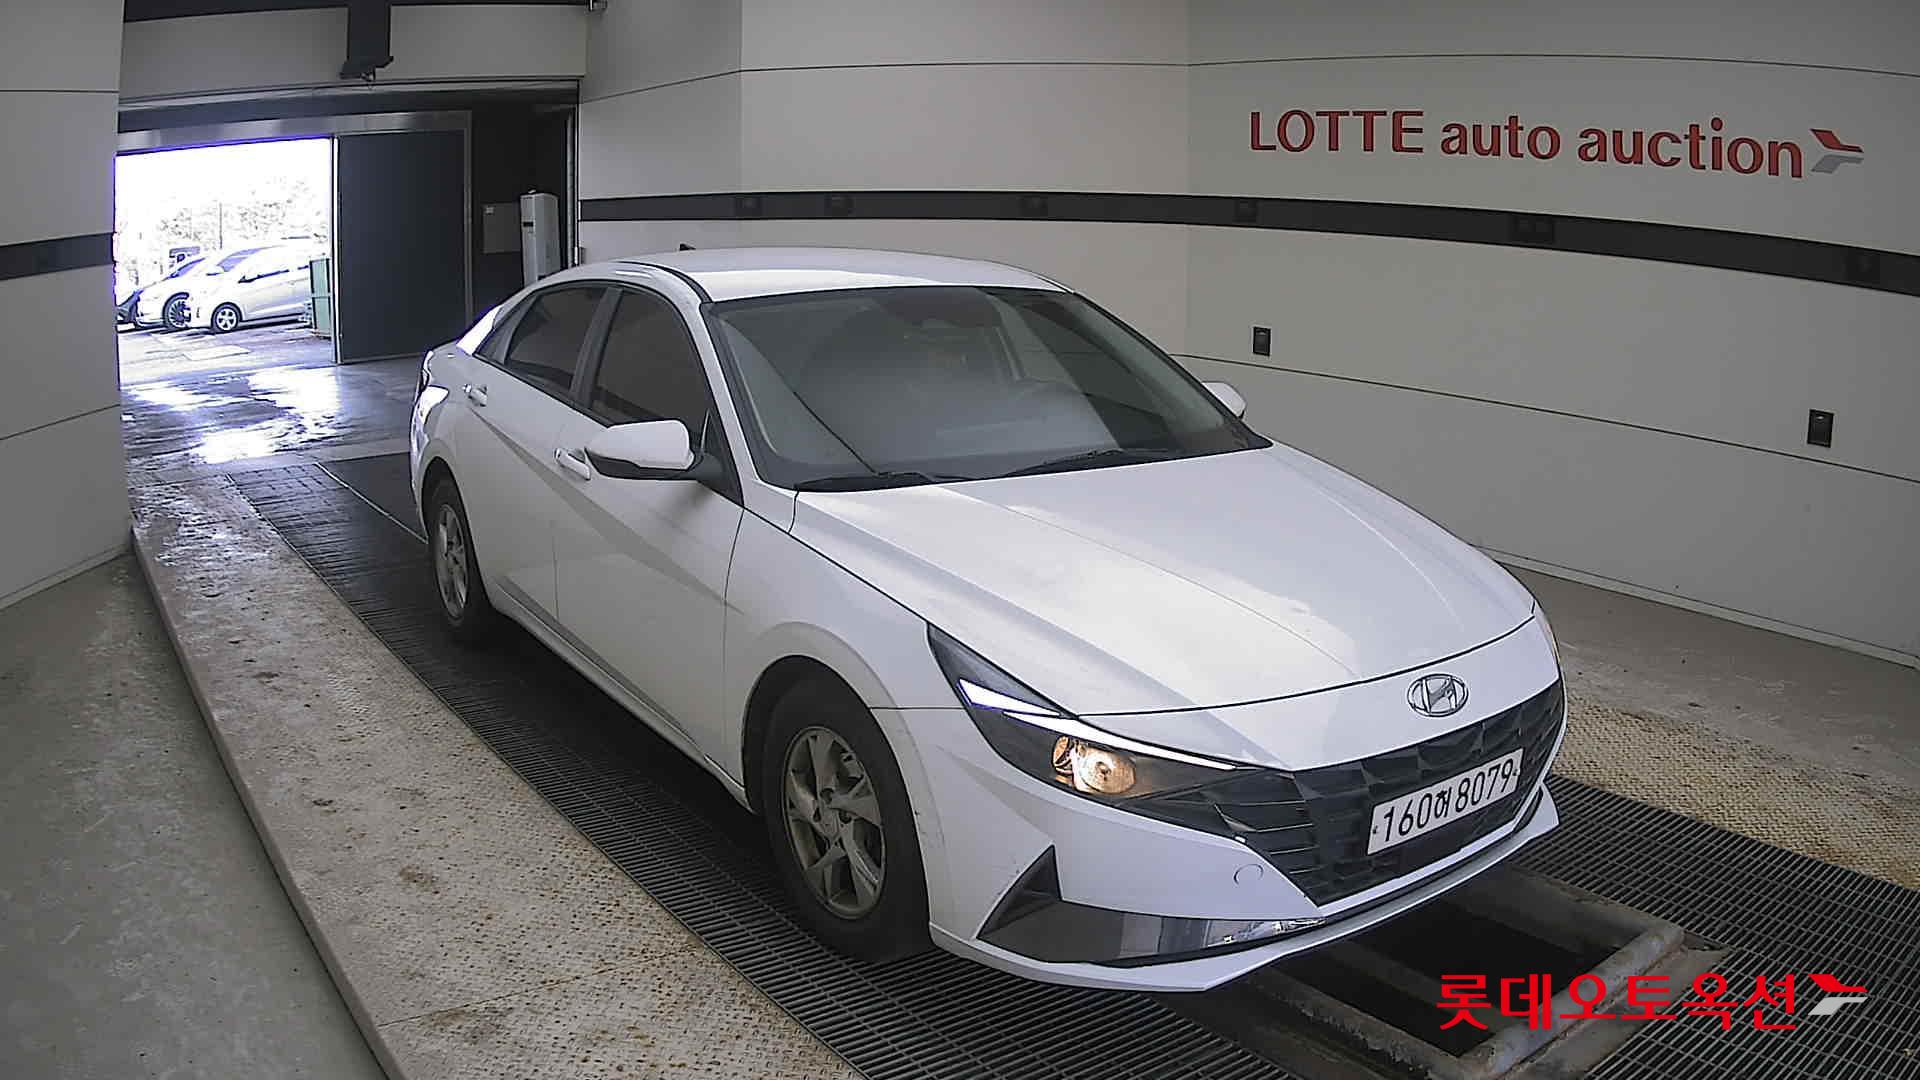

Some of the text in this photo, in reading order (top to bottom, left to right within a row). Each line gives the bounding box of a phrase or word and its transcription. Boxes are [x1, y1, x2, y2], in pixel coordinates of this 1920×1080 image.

[1250, 110, 1804, 178] LOTTE auto auction
